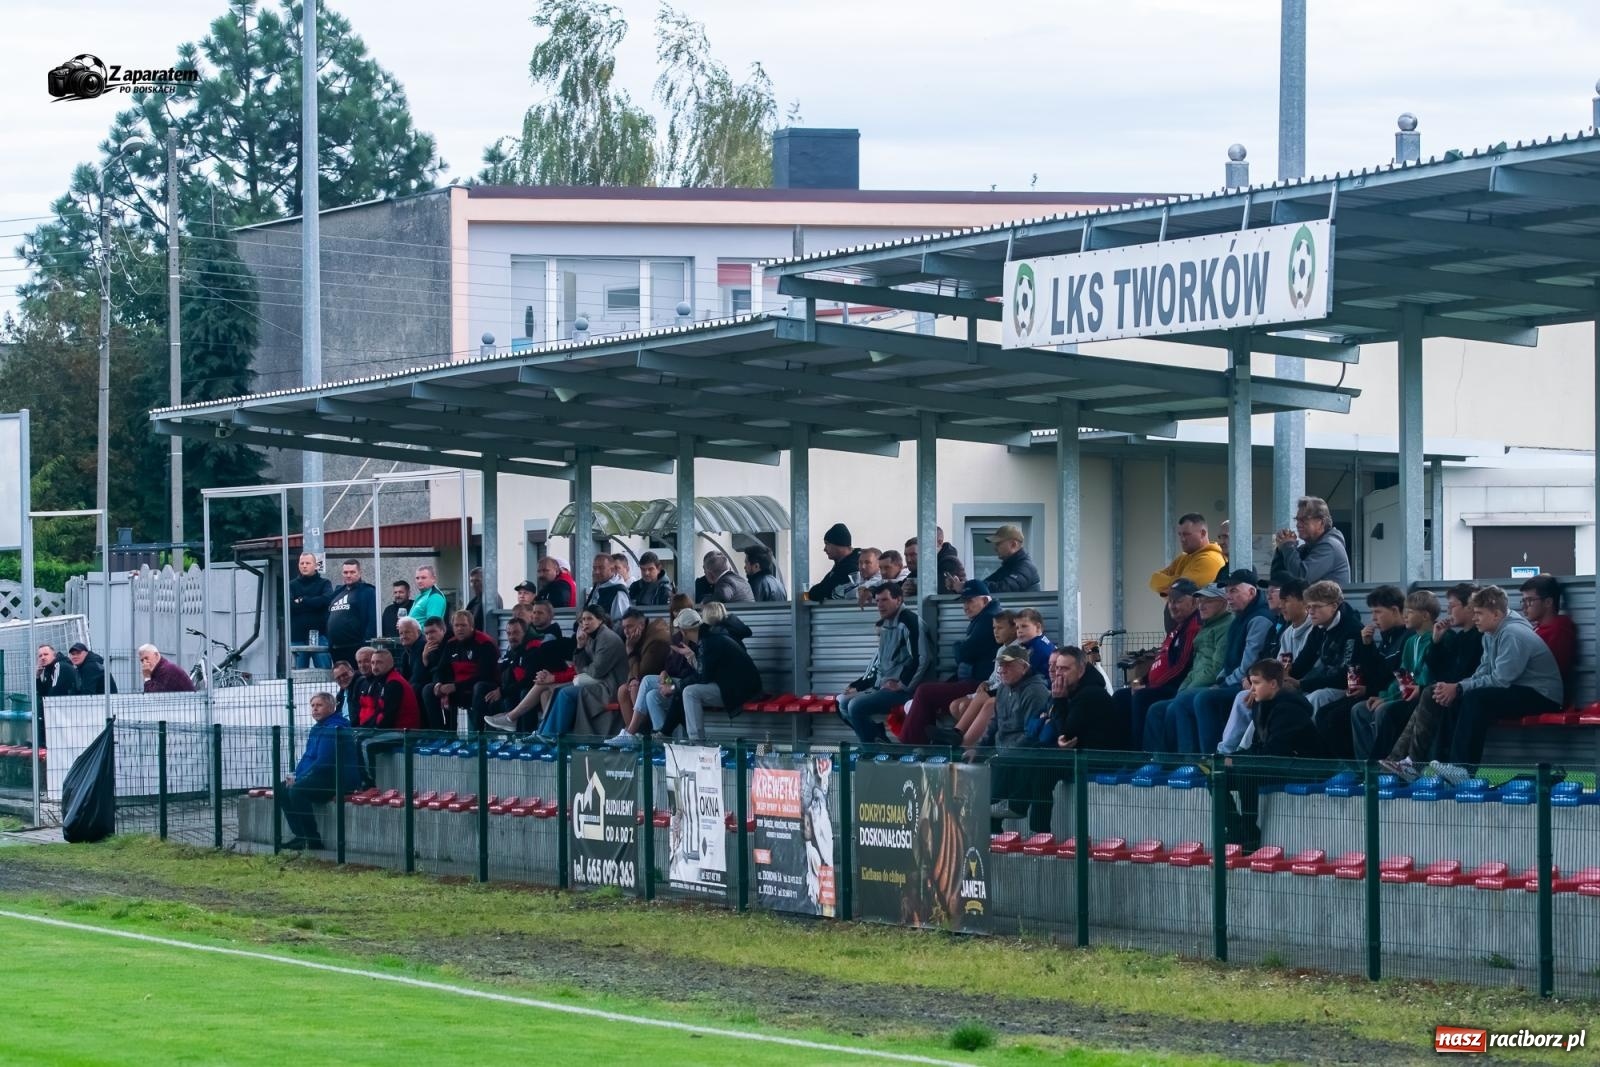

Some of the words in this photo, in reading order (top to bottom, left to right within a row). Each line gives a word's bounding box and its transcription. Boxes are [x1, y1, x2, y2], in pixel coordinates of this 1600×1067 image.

[1051, 271, 1104, 336] LKS
[1113, 239, 1270, 330] TWORKÓW
[756, 775, 799, 800] KREWETKA
[605, 800, 634, 816] BUDUJEMY
[699, 795, 720, 817] OKNA
[859, 803, 886, 822] ODKRYJ
[886, 804, 907, 824] SMAK
[605, 826, 615, 842] OD
[615, 827, 620, 842] A
[620, 827, 629, 843] DO
[859, 825, 912, 849] DOSKONAŁOŚCI
[573, 855, 585, 882] tel.
[586, 858, 601, 884] 665
[602, 859, 618, 885] 092
[619, 860, 635, 888] 363
[960, 879, 987, 899] JANETA
